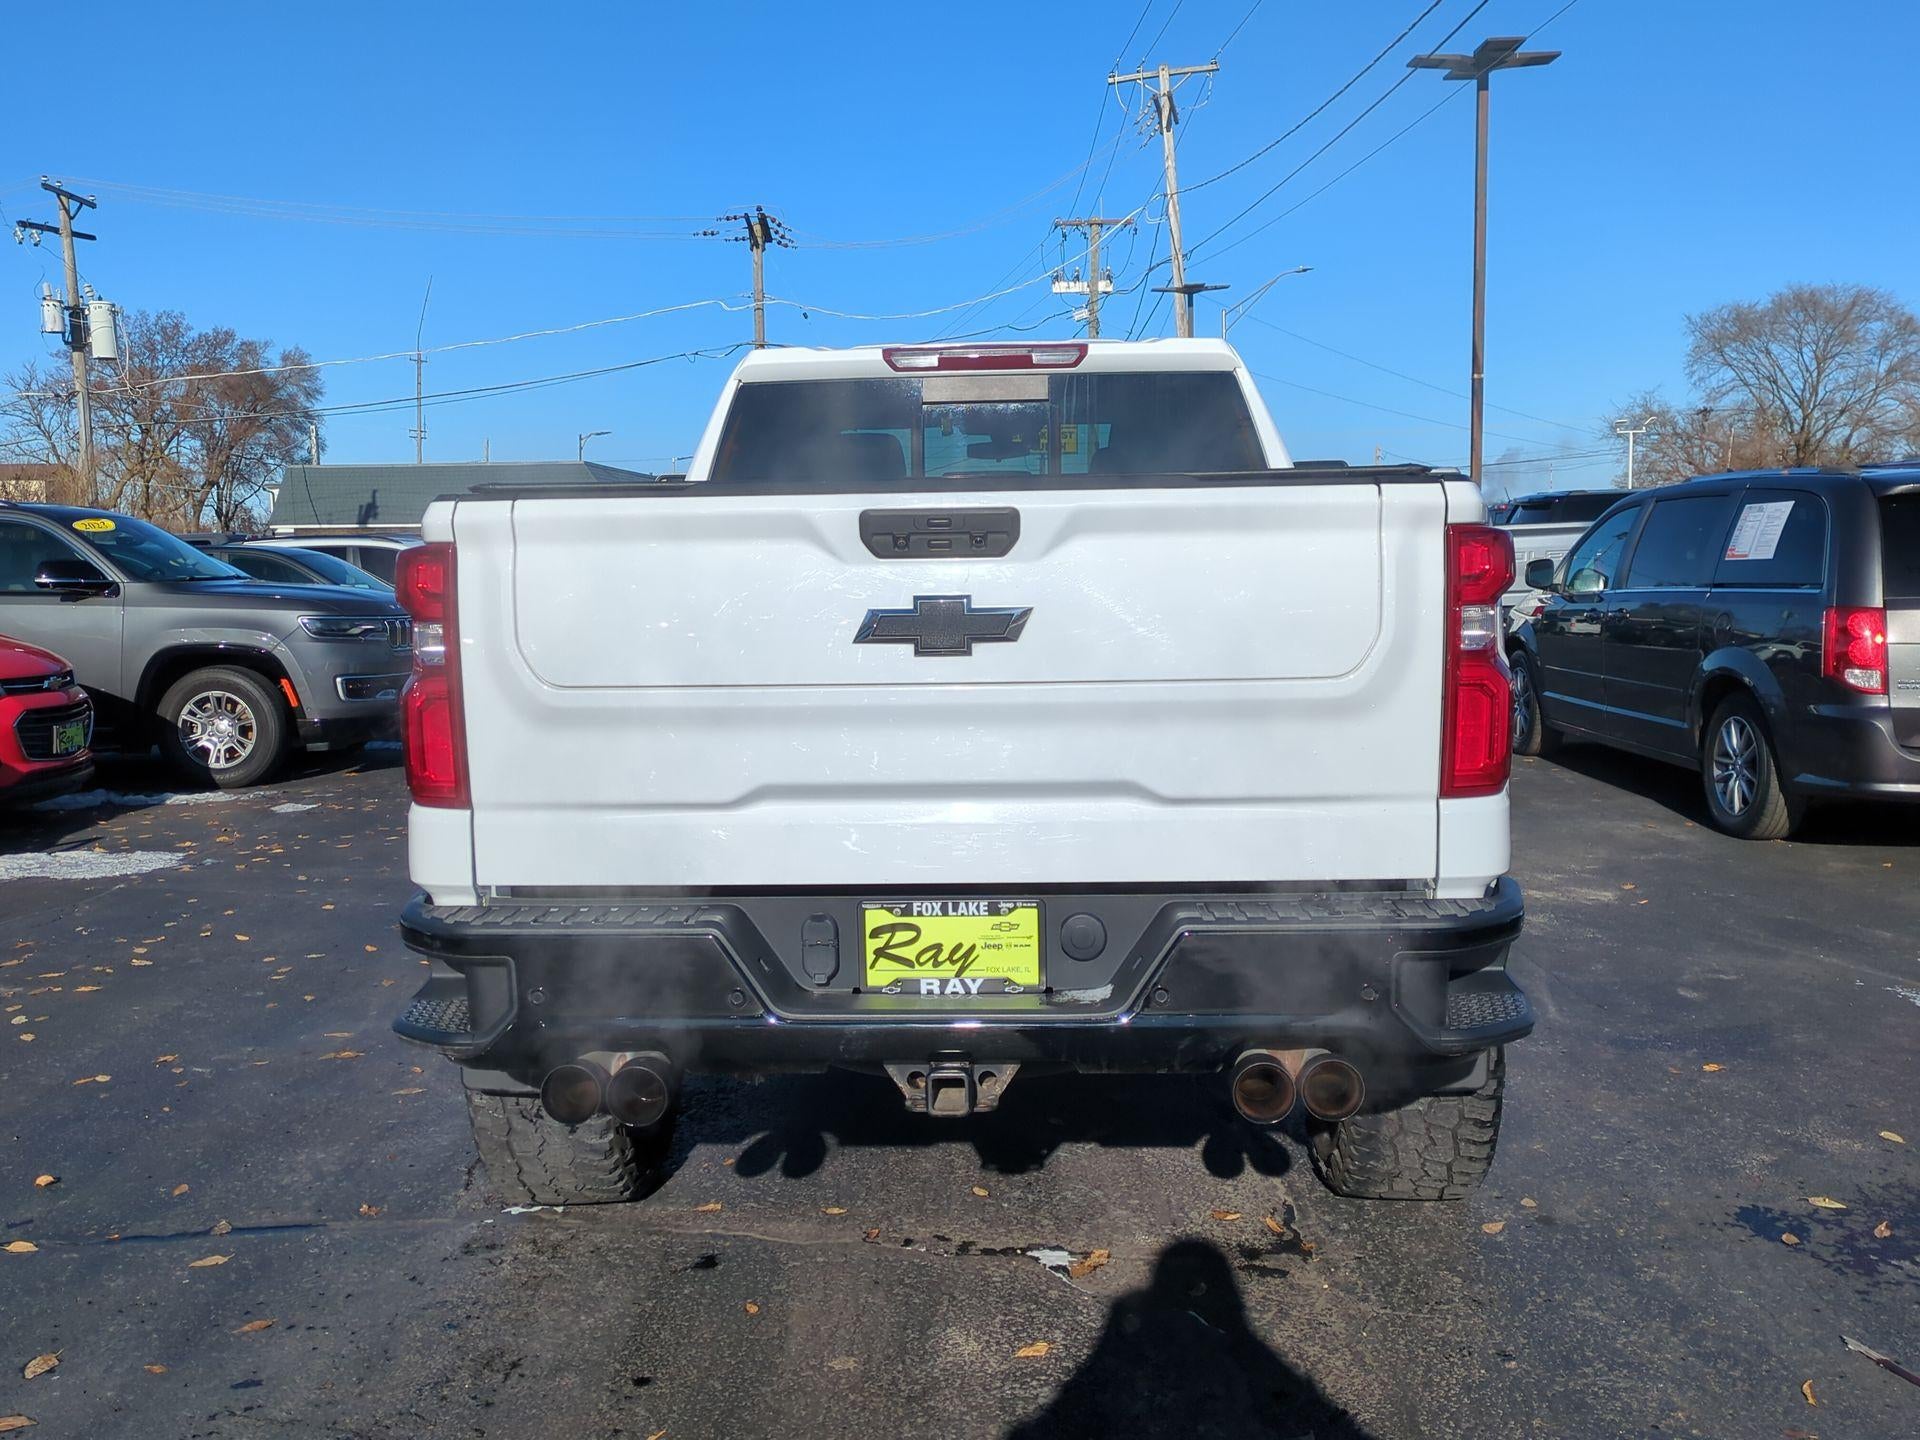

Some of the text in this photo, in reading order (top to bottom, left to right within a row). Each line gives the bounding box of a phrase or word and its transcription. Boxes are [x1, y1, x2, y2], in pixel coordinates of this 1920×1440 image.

[912, 901, 989, 916] FOX LAKE
[869, 922, 980, 978] Ray
[981, 942, 1003, 952] Jeep
[920, 978, 985, 994] RAY
